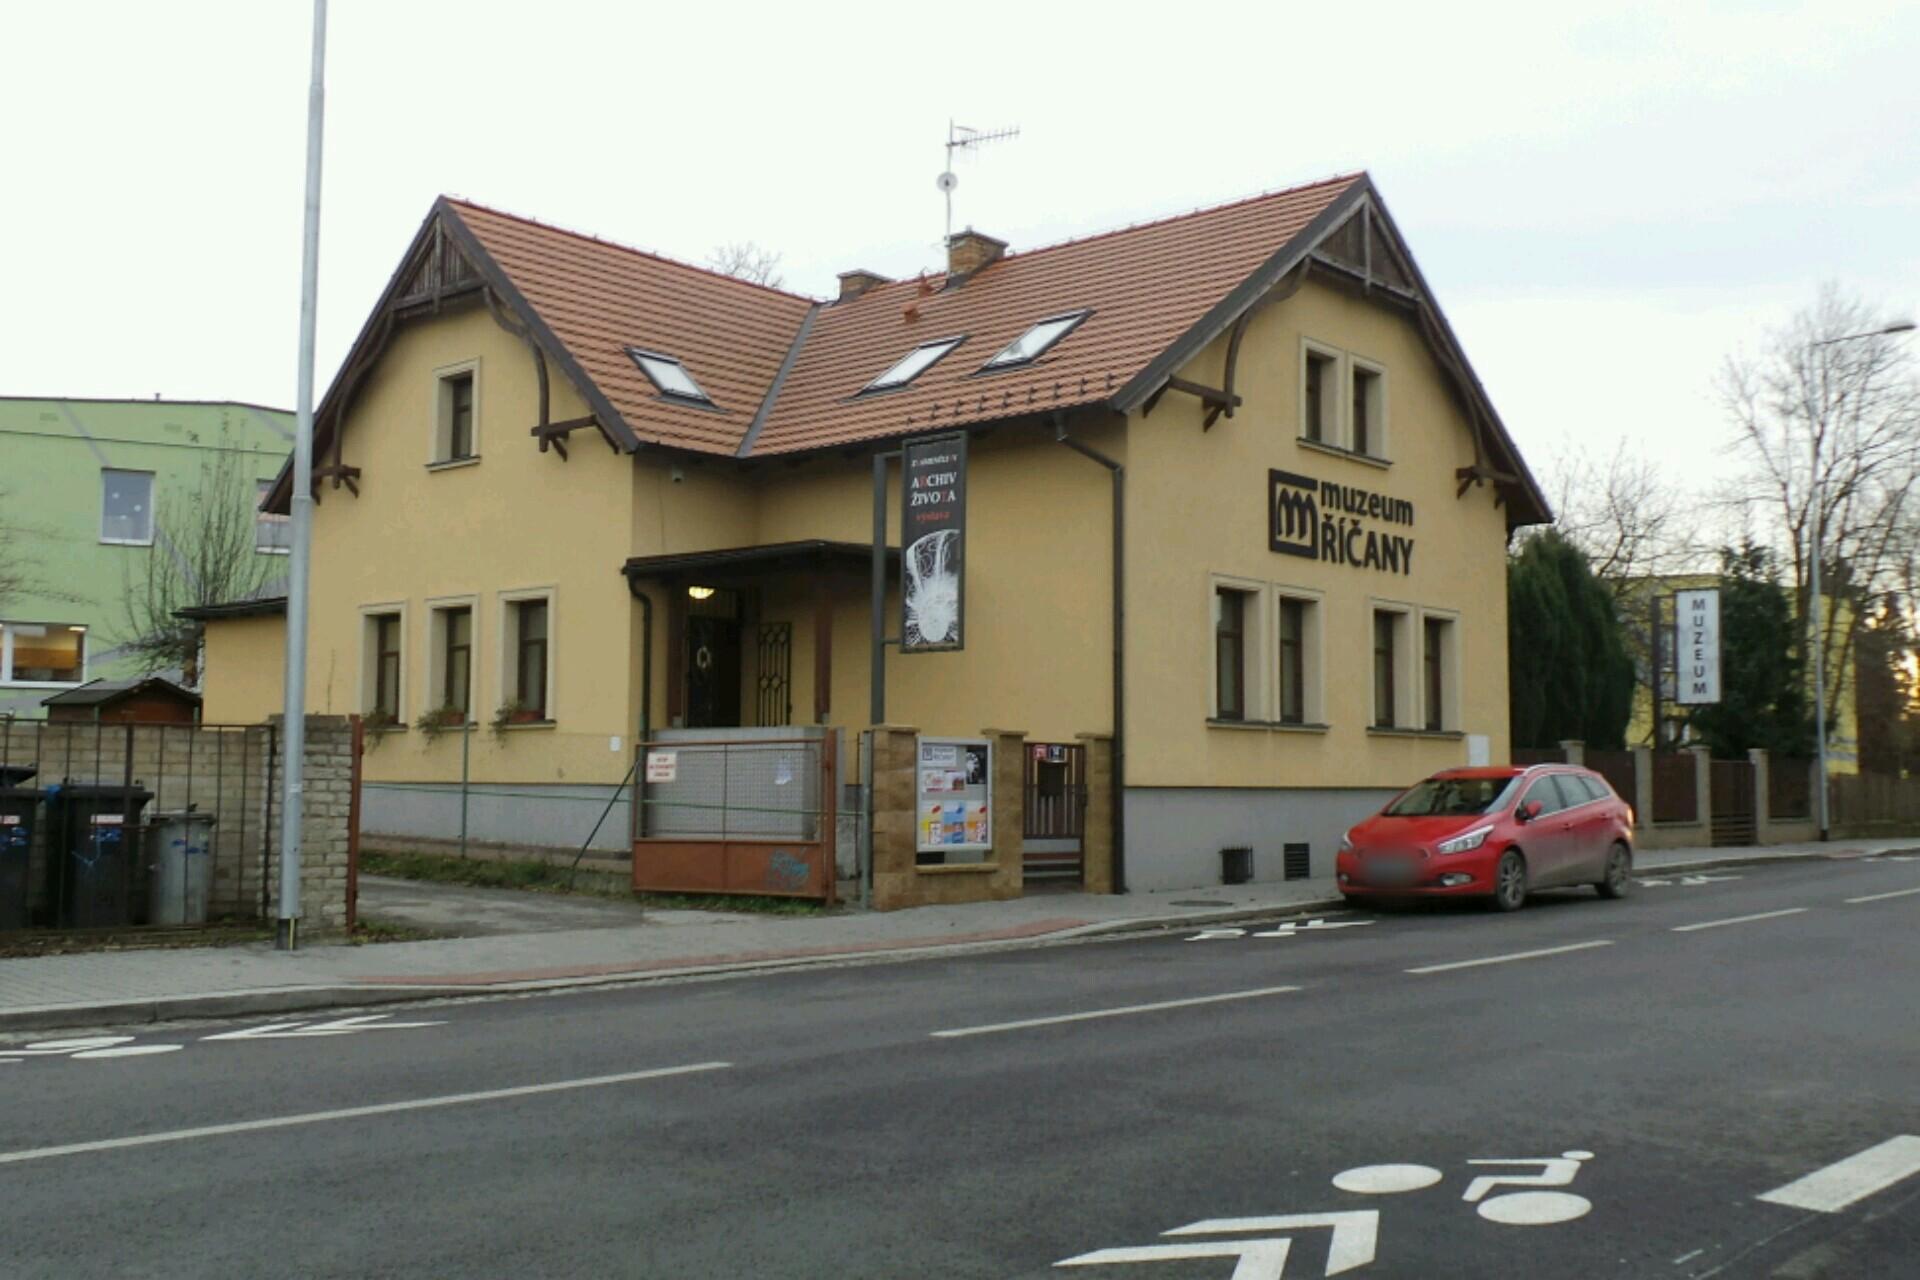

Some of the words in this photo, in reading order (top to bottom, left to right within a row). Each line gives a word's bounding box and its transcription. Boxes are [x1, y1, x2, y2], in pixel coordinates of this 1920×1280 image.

[911, 472, 957, 488] ARCHIV
[911, 490, 956, 506] ŽIVOTA
[1321, 481, 1414, 526] muzeum
[1321, 513, 1414, 576] ŘÍČANY
[1692, 598, 1707, 695] MUZEUM
